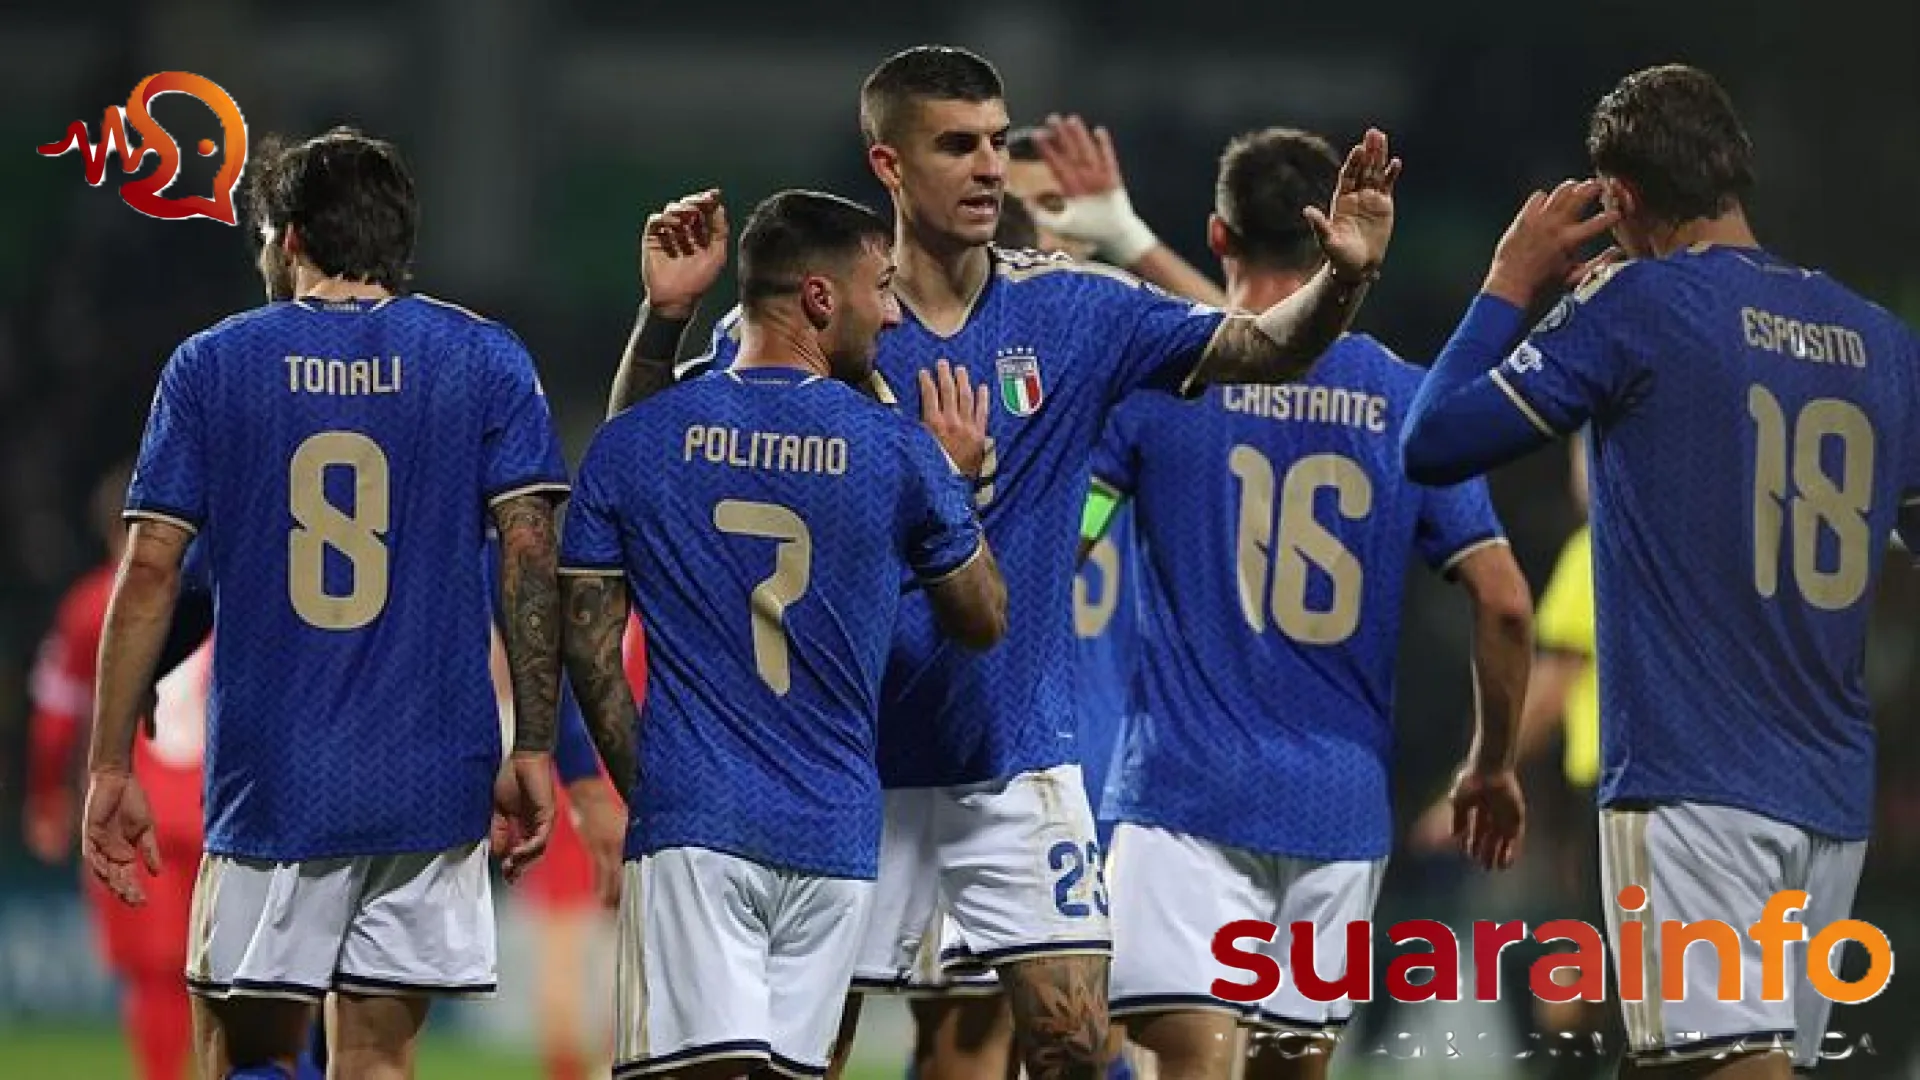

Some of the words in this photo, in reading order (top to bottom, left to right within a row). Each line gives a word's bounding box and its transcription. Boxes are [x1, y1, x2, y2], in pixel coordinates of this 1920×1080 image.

[284, 355, 401, 396] TONALI
[1741, 306, 1866, 368] ESPOSITO
[289, 430, 390, 630] 8
[685, 425, 848, 475] POLITANO
[1229, 444, 1373, 645] 16
[1749, 384, 1874, 609] 18
[713, 499, 812, 697] 7
